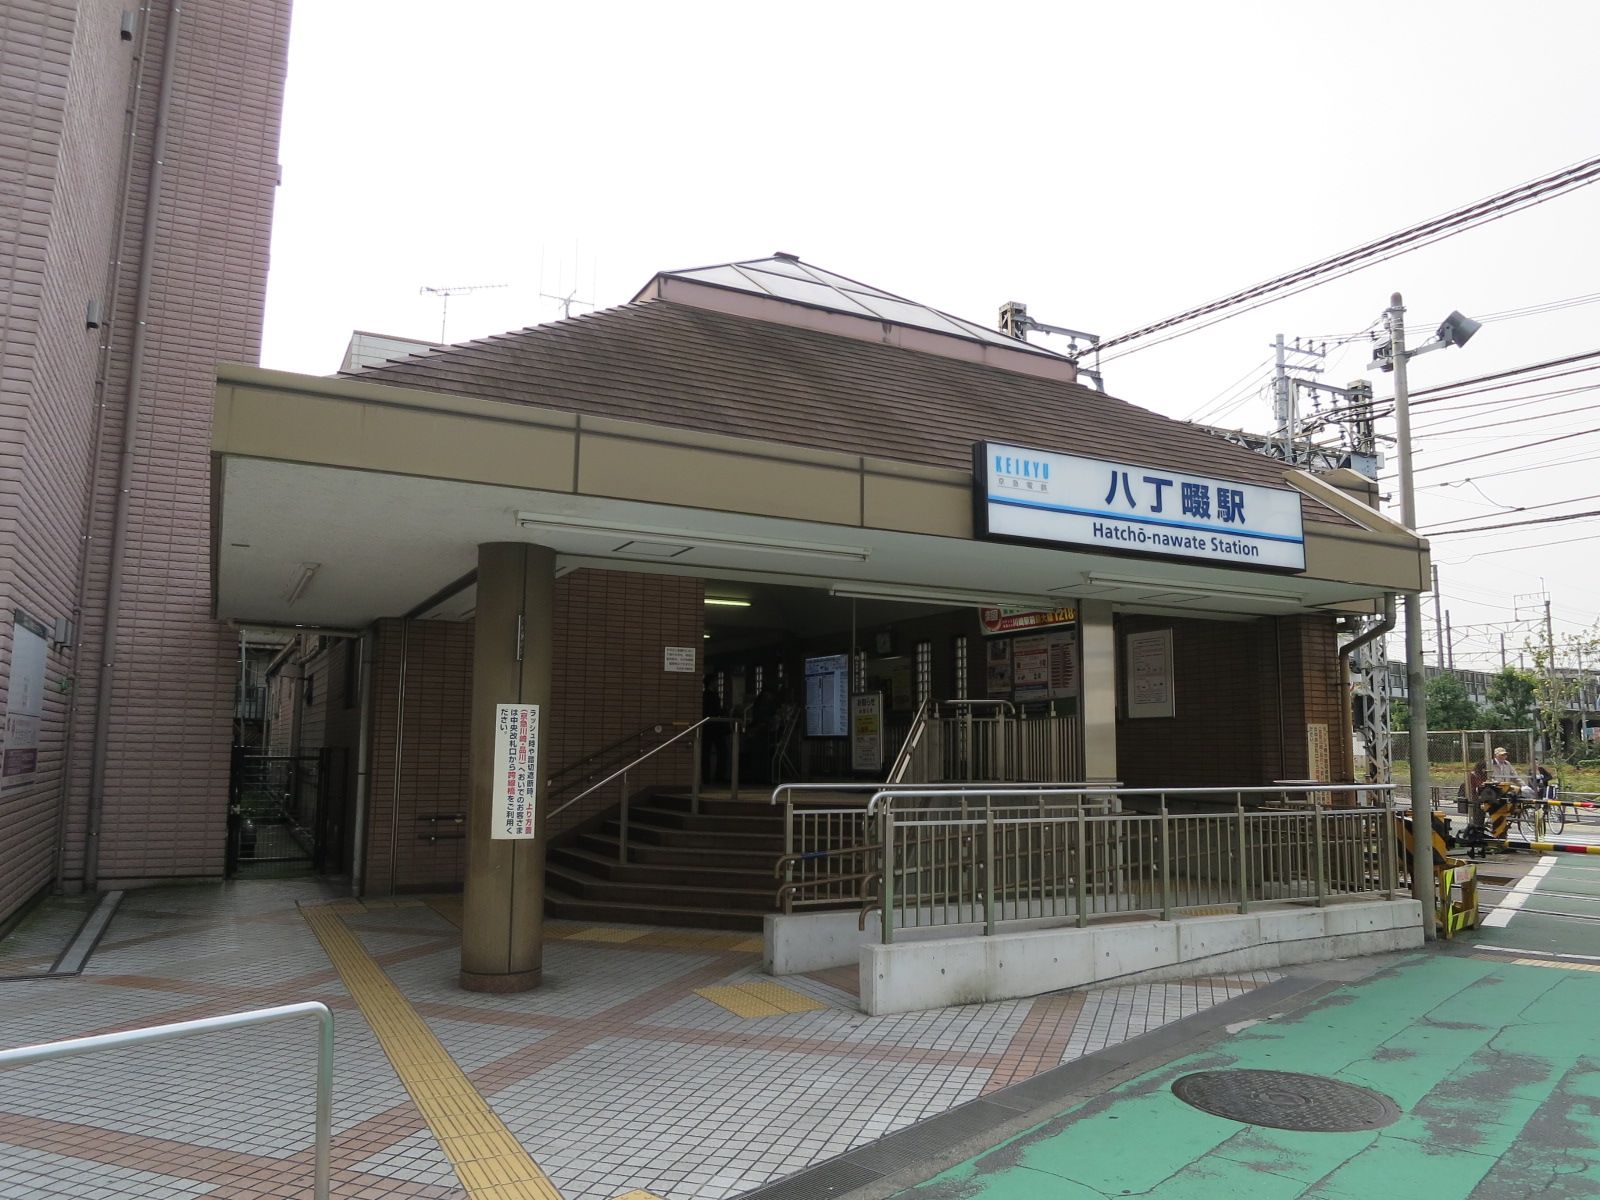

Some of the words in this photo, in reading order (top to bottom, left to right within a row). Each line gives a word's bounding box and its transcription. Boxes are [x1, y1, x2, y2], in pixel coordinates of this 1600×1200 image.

[996, 456, 1049, 480] KEIKYU
[1104, 470, 1246, 524] 八丁畷駅
[1093, 521, 1207, 551] Hatchō-nawate
[1210, 537, 1259, 557] Station
[500, 709, 509, 734] ださい。
